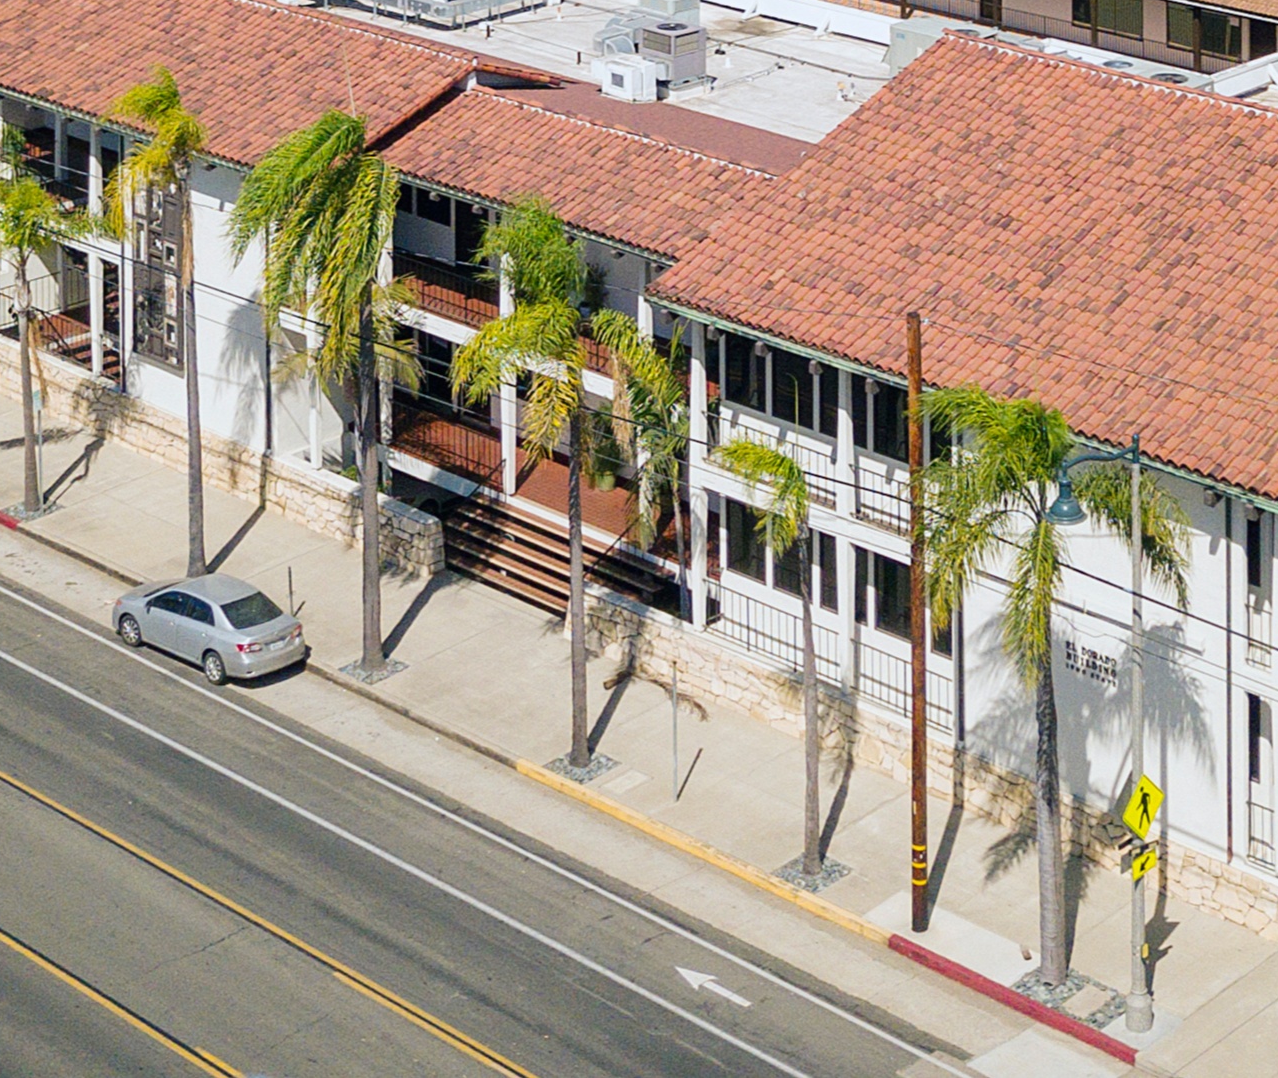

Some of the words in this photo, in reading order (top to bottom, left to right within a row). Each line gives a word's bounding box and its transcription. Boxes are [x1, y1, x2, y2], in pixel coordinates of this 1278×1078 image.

[1065, 640, 1077, 652] EL
[1081, 646, 1117, 668] DORADO
[1066, 650, 1117, 678] BUILDING
